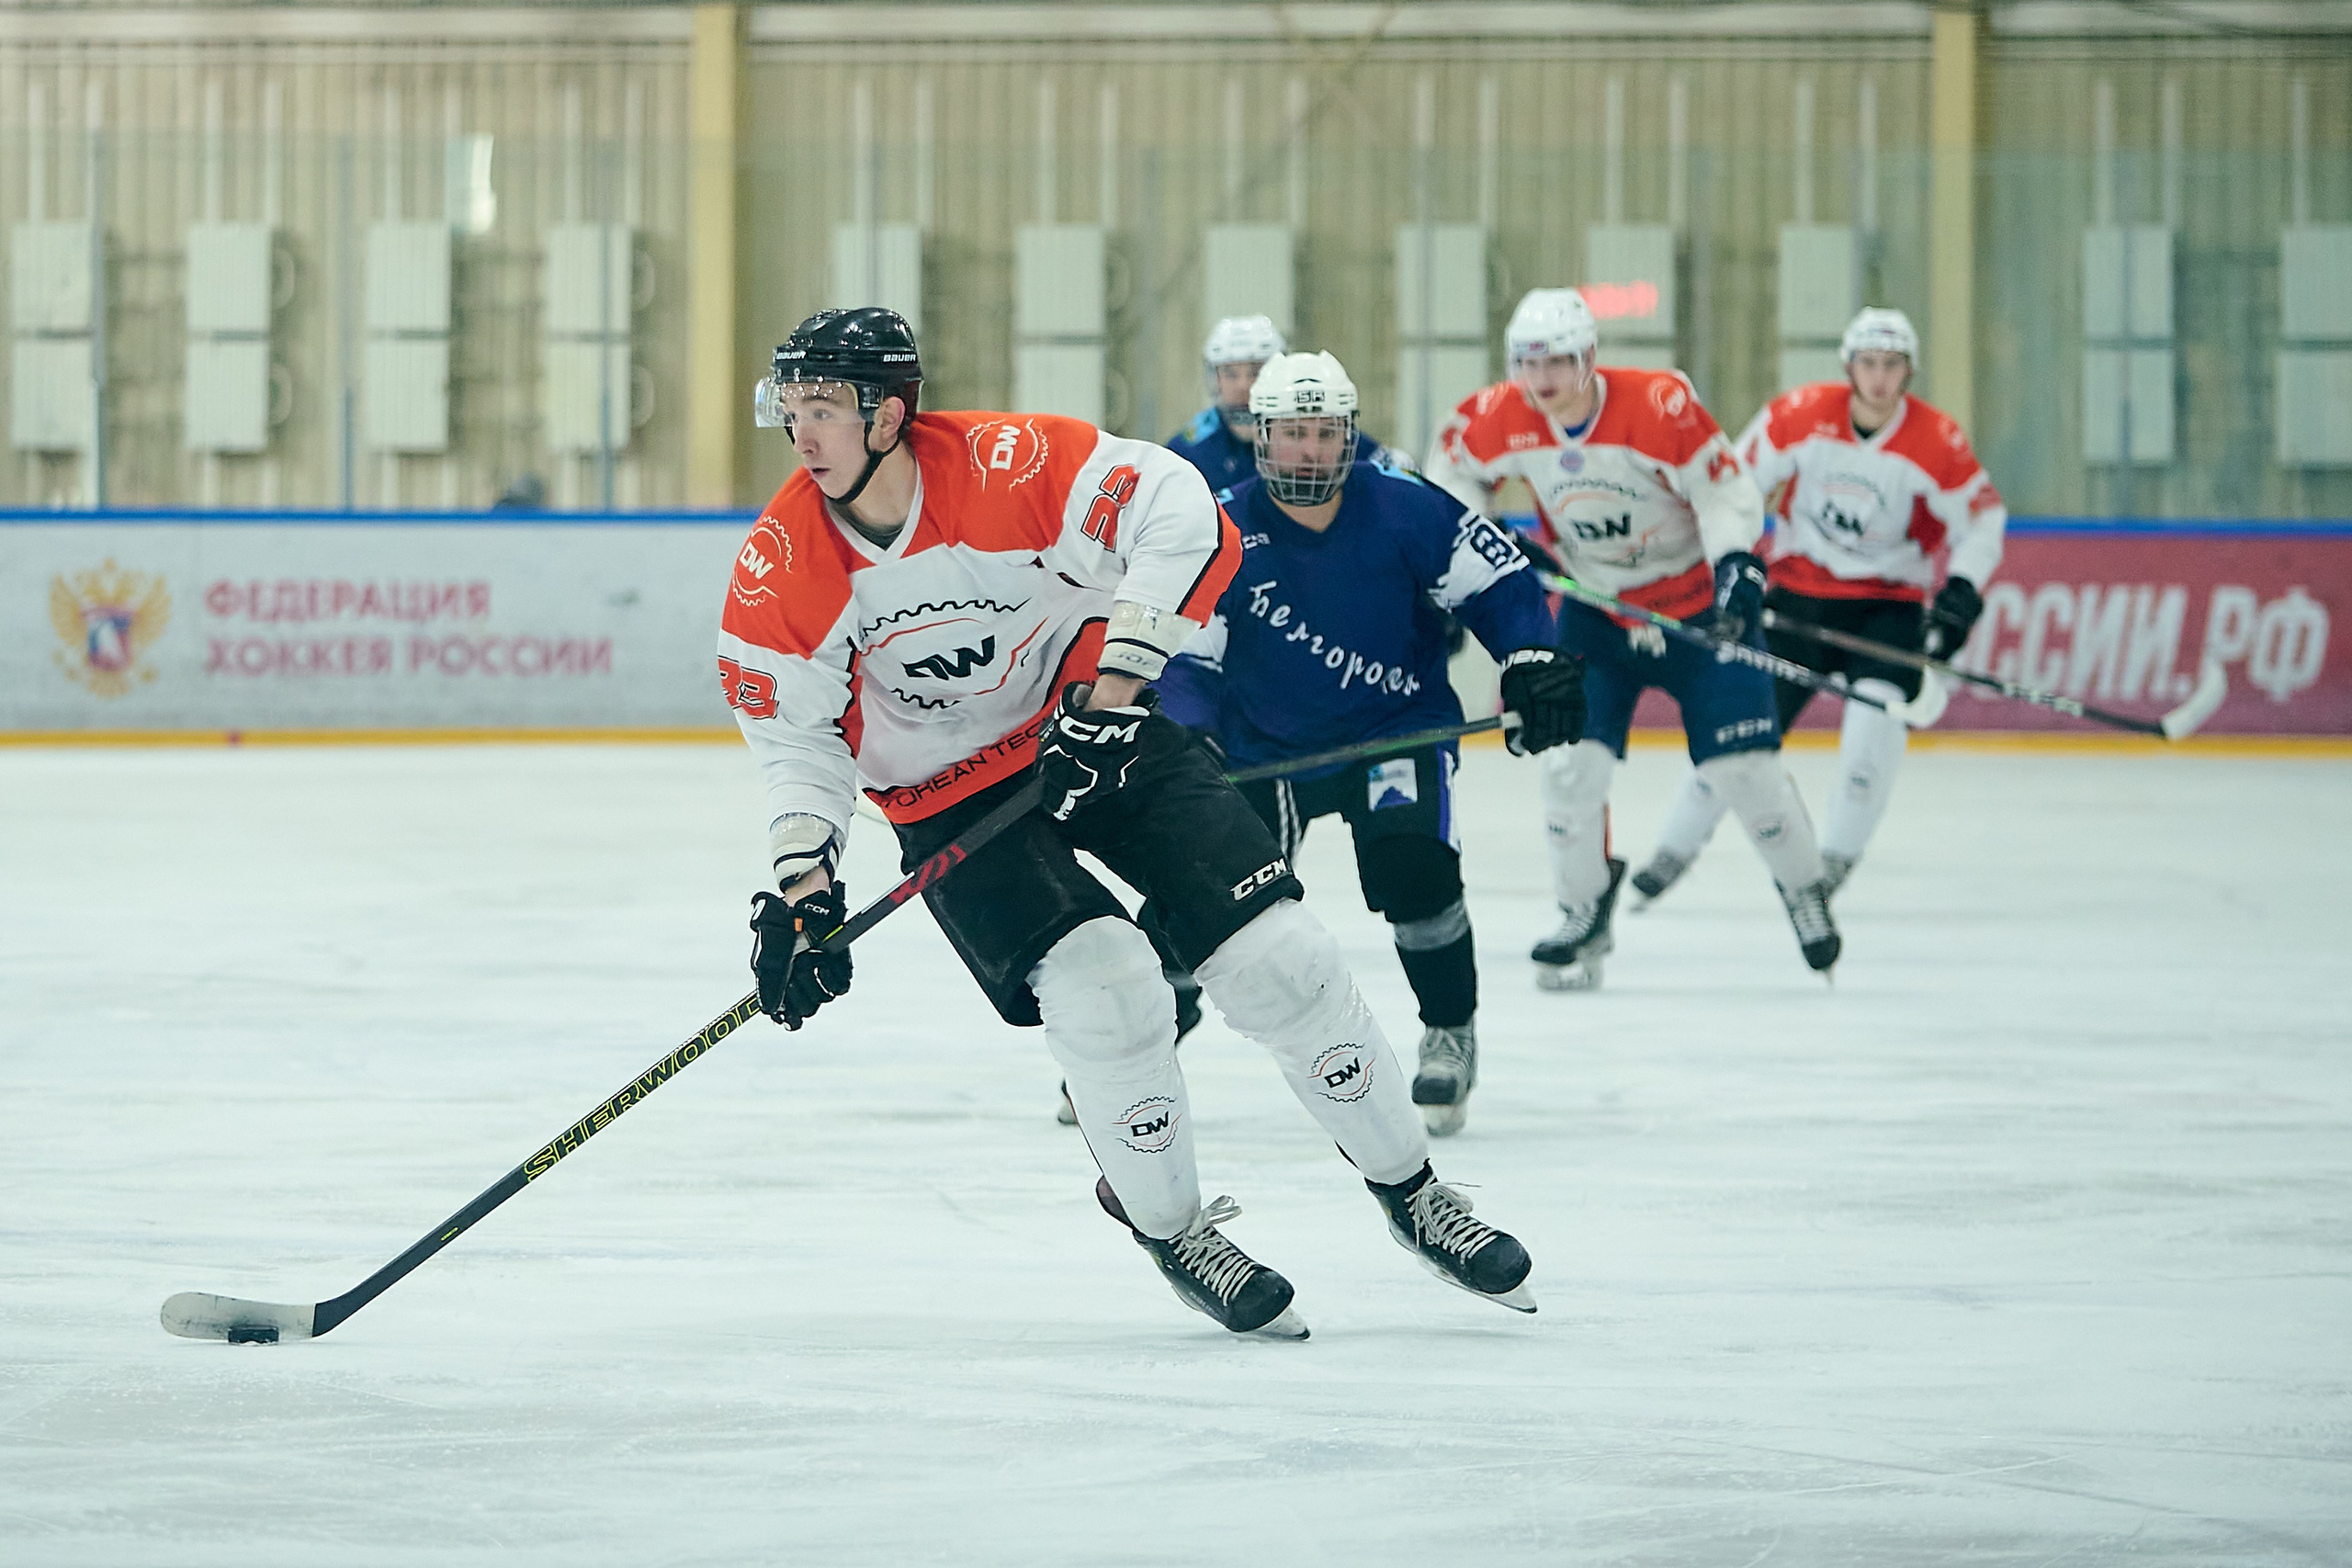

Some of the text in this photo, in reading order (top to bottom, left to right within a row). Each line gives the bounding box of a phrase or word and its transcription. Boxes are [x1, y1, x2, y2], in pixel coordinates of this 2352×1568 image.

[883, 354, 917, 363] BAUER
[740, 541, 774, 580] DW
[204, 580, 491, 625] ФЕДЕРАЦИЯ
[204, 634, 613, 678] ХОККЕЯ РОССИИ
[1951, 581, 2330, 704] ССИИ.РФ
[885, 717, 1046, 807] OREAN TEC
[1230, 858, 1287, 901] CCM
[804, 903, 830, 916] CCM
[1324, 1056, 1361, 1089] DW
[1130, 1111, 1170, 1137] DW
